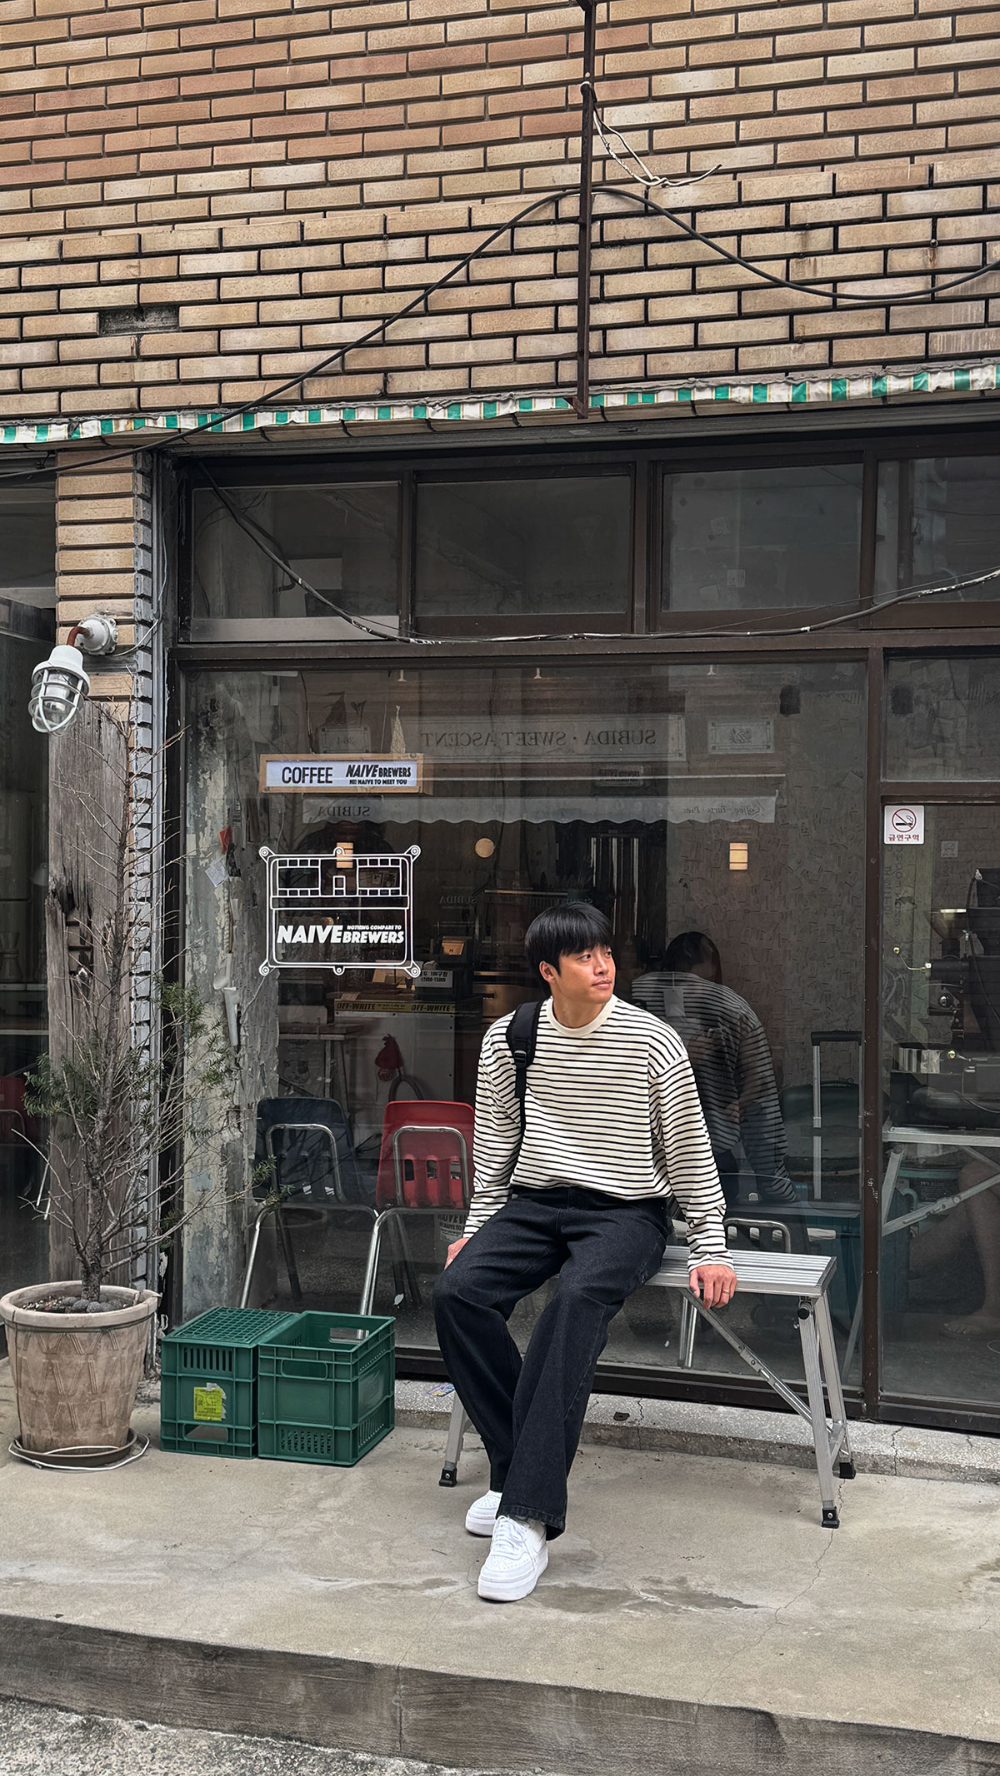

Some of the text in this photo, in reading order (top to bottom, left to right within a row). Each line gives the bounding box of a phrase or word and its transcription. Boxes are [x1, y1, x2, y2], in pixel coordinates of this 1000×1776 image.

[281, 766, 334, 784] COFFEE
[345, 764, 412, 778] NAIVE BREWERS
[888, 834, 920, 842] 금연구역
[276, 925, 405, 944] NAIVE BREWERS
[336, 1002, 376, 1010] OFF-WHITE
[410, 1004, 451, 1012] OFF-WHITE
